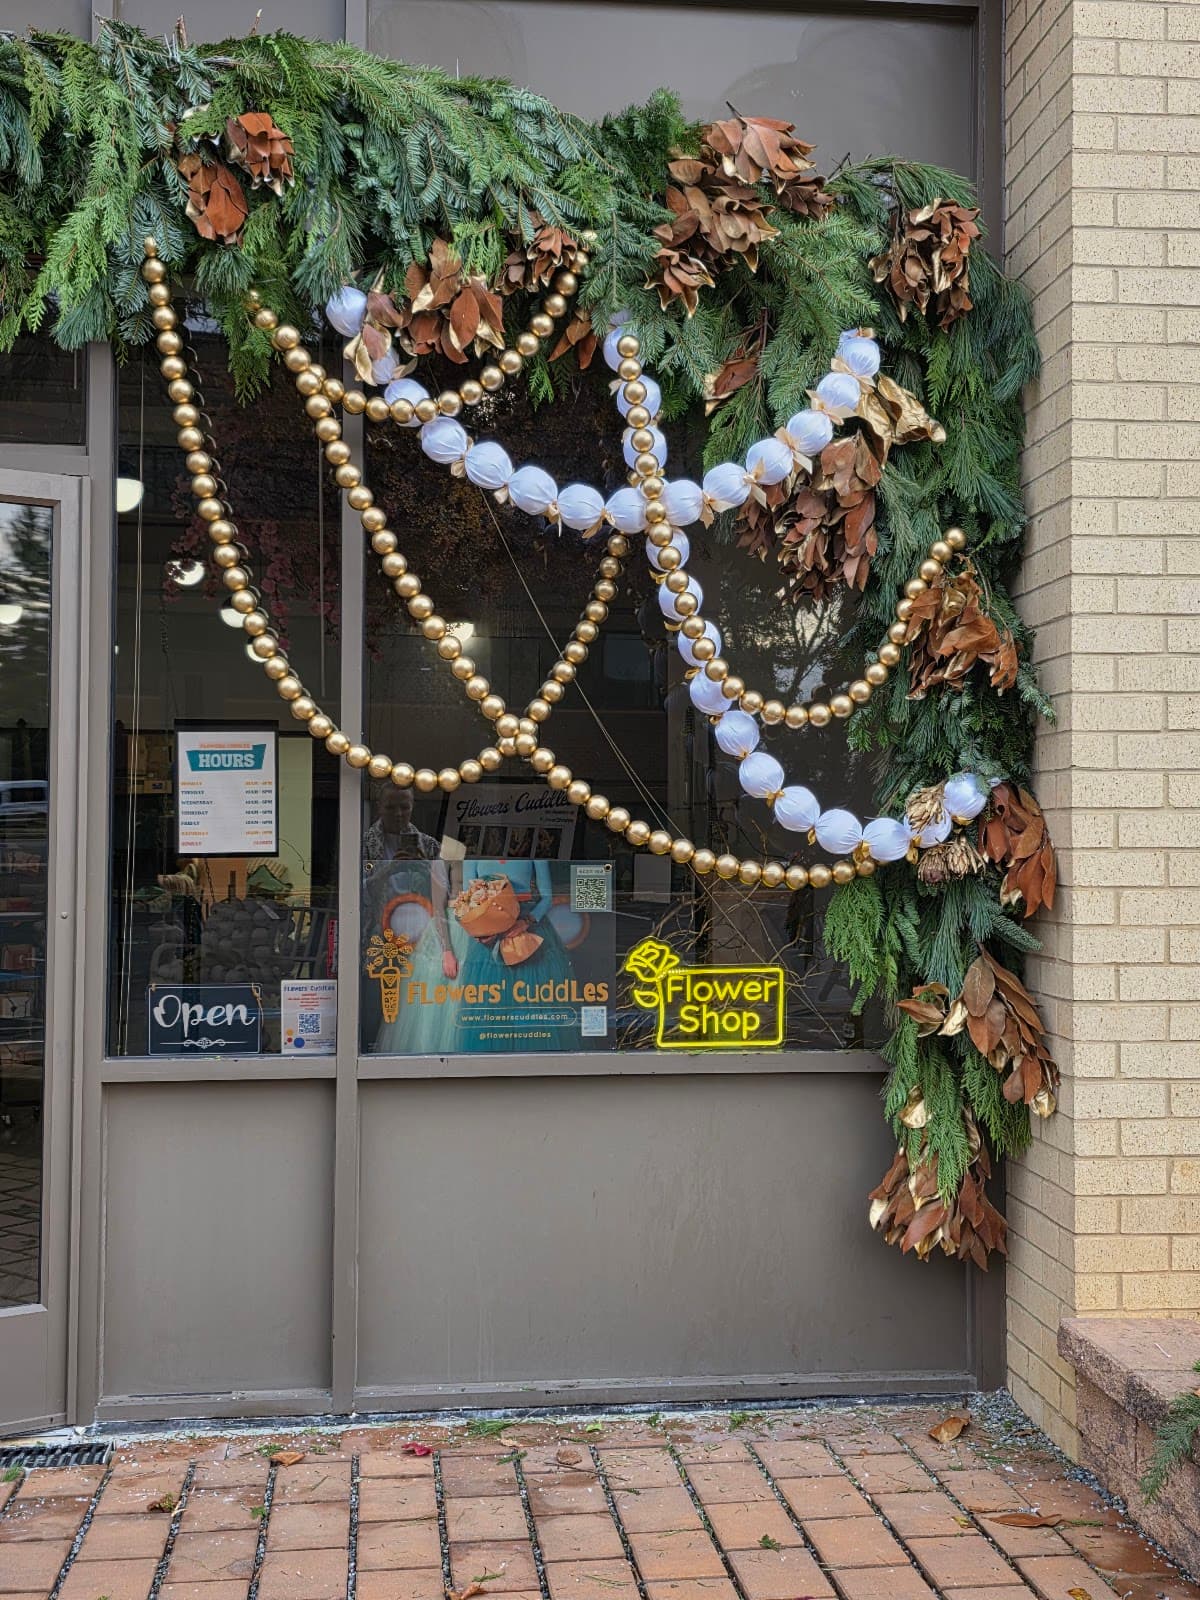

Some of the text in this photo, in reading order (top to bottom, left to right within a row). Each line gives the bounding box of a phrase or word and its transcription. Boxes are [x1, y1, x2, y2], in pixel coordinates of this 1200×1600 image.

[198, 753, 255, 768] HOURS
[666, 974, 779, 1003] Flower
[153, 994, 256, 1038] Open
[461, 1013, 569, 1022] www.flowerscuddles.com
[679, 1004, 760, 1040] Shop
[479, 1031, 552, 1041] @flowerscuddles
